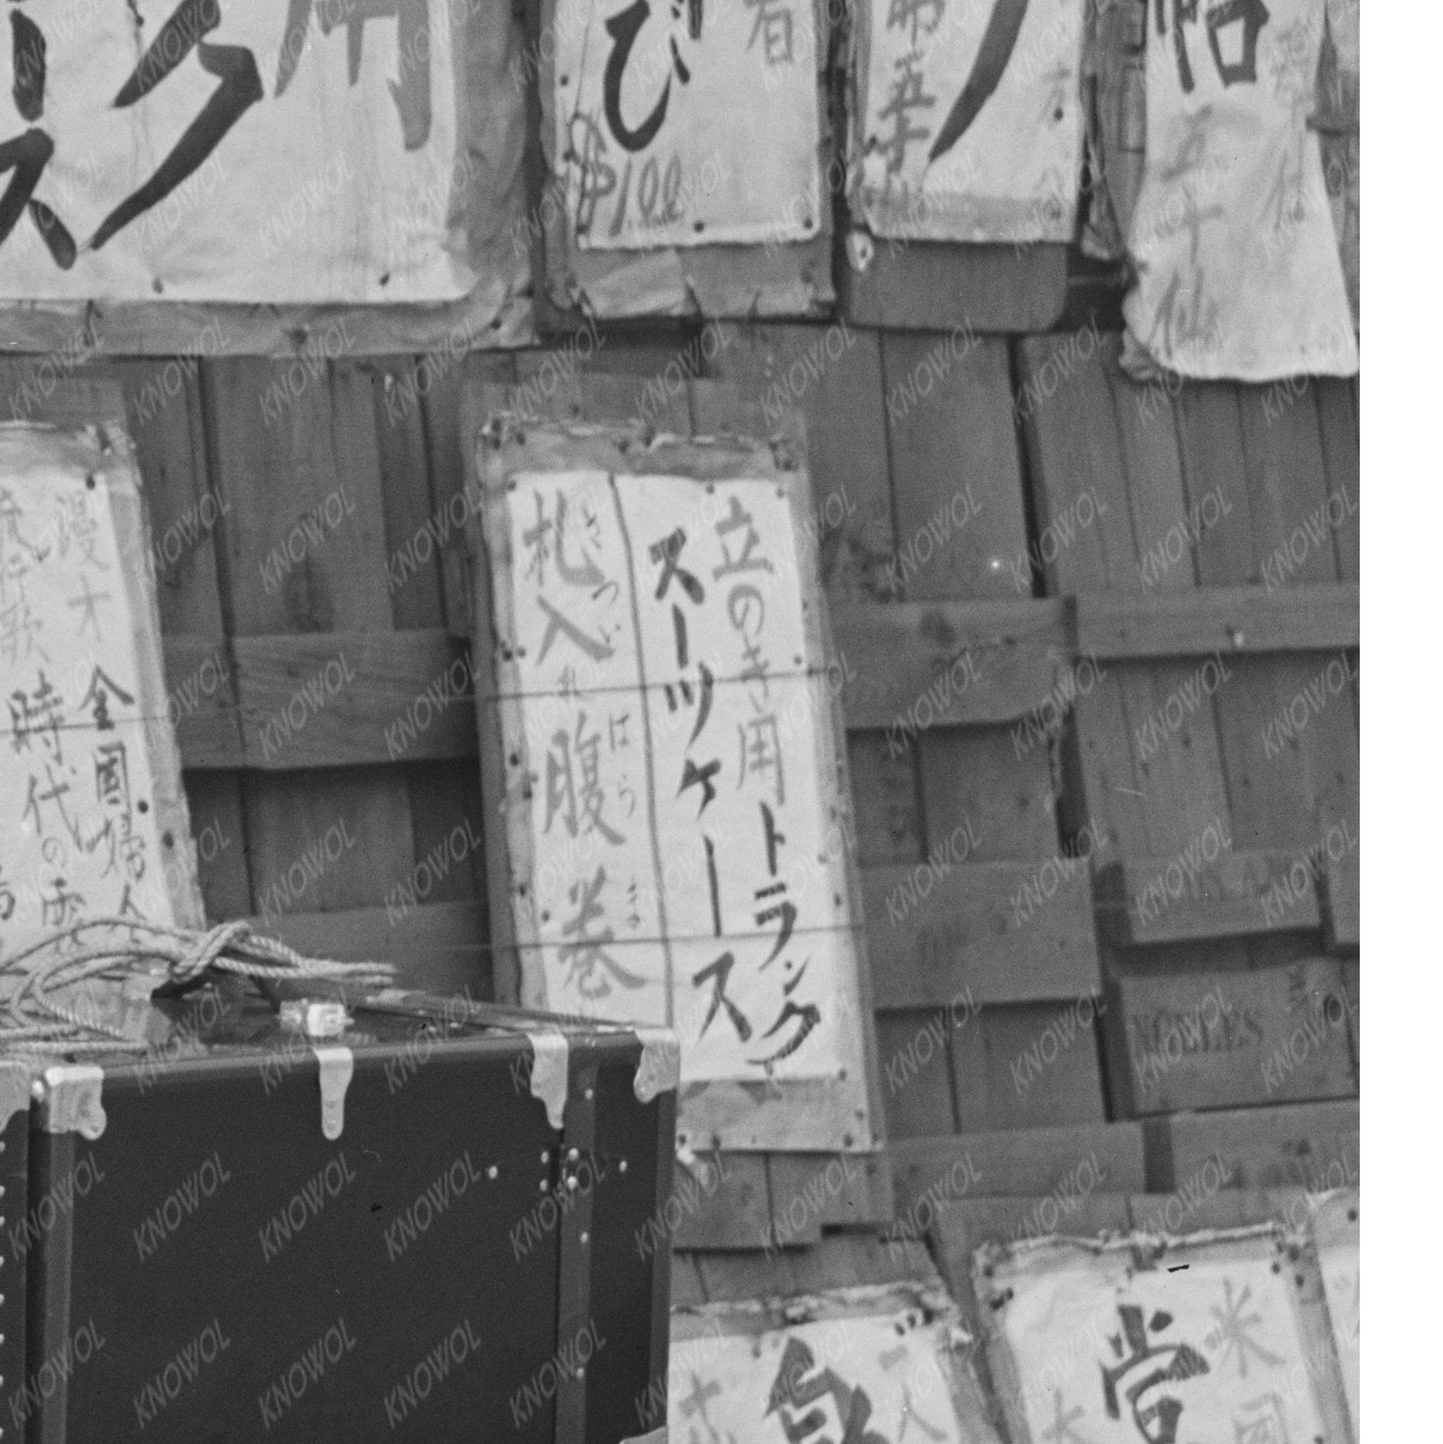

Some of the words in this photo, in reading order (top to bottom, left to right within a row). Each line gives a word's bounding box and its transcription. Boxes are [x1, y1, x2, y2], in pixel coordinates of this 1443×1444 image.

[543, 706, 646, 999] 腹巻
[648, 527, 753, 1044] スーツケース
